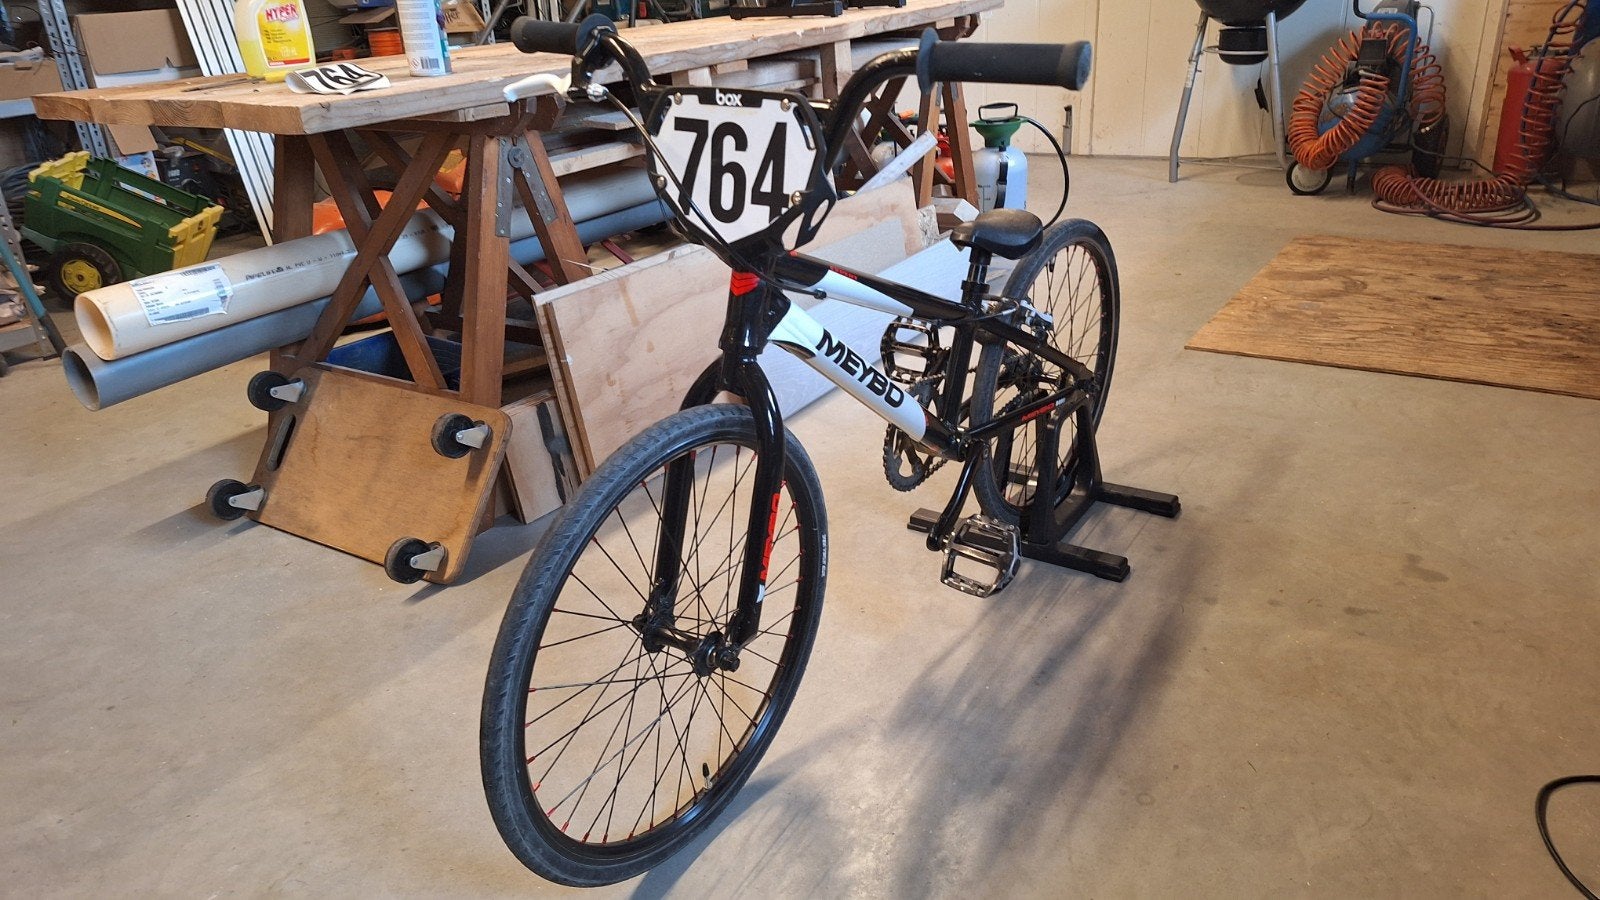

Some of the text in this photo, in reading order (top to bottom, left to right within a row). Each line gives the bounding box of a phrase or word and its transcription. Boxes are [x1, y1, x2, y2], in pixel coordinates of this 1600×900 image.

[265, 3, 299, 21] HYPER
[302, 64, 373, 90] 764
[715, 89, 743, 107] box
[674, 116, 791, 223] 764
[816, 328, 905, 408] MEYBO
